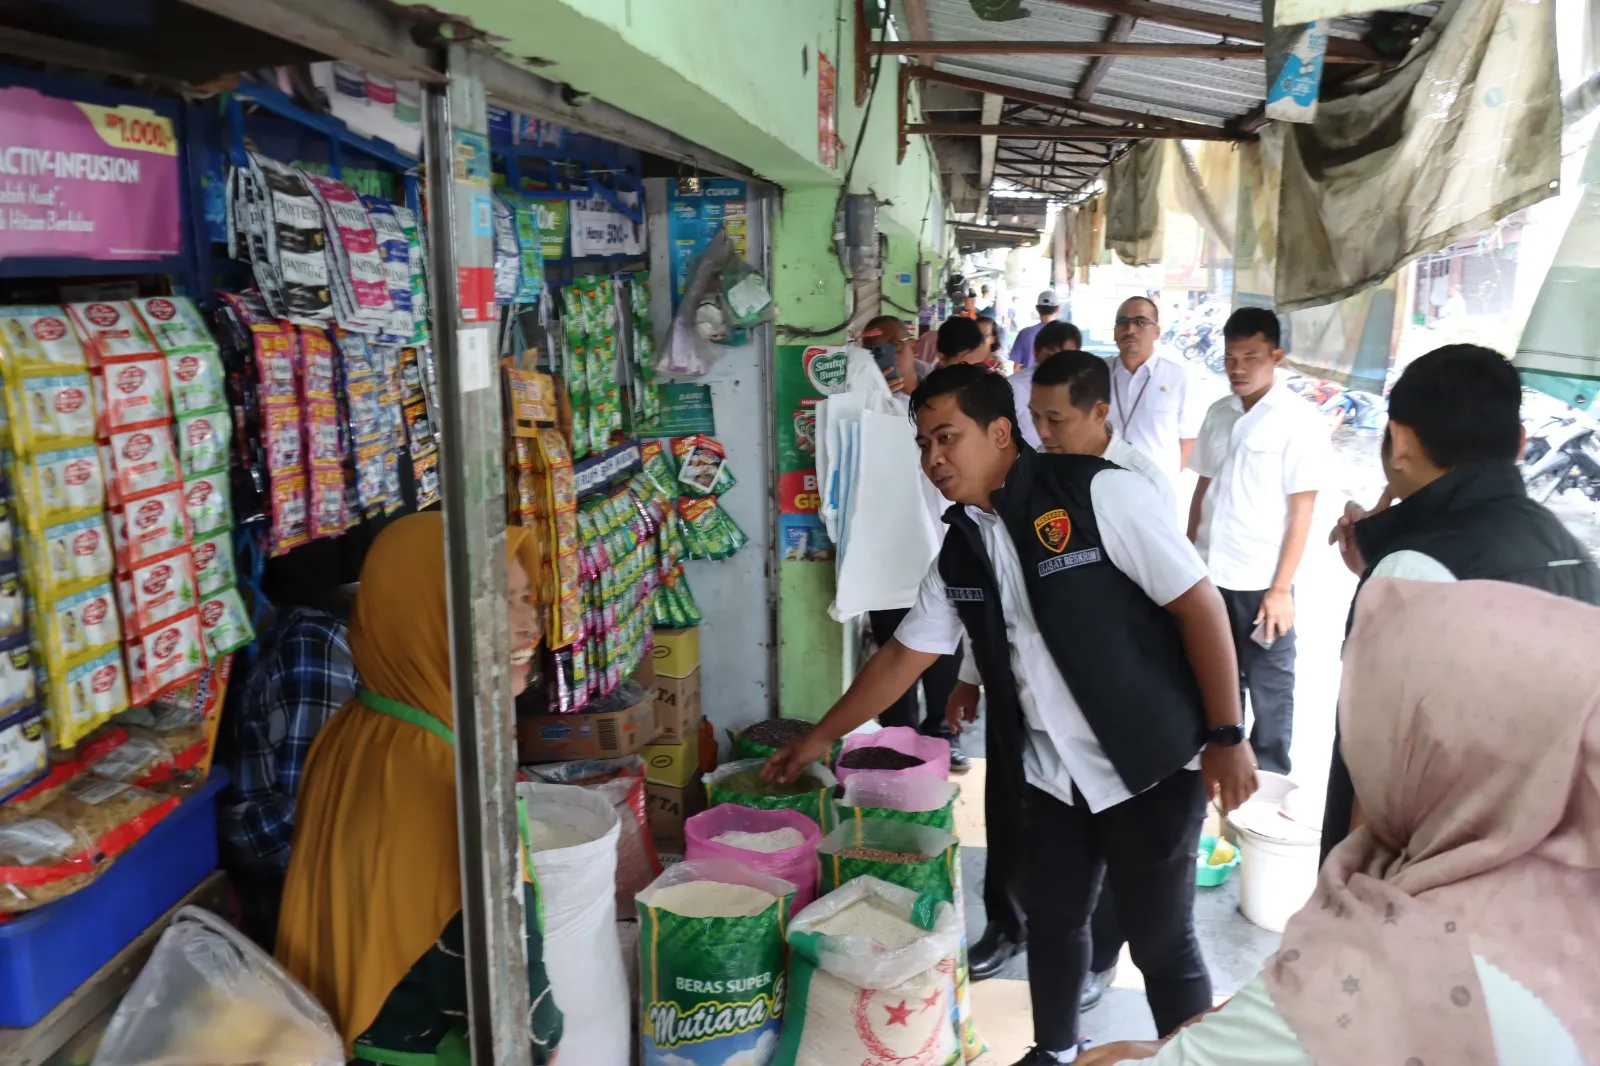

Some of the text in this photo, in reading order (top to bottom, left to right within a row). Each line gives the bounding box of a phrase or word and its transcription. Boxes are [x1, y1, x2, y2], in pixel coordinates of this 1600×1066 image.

[1063, 550, 1098, 567] RESKRIM
[675, 971, 772, 994] BERAS SUPER
[649, 997, 767, 1046] Mutiara
